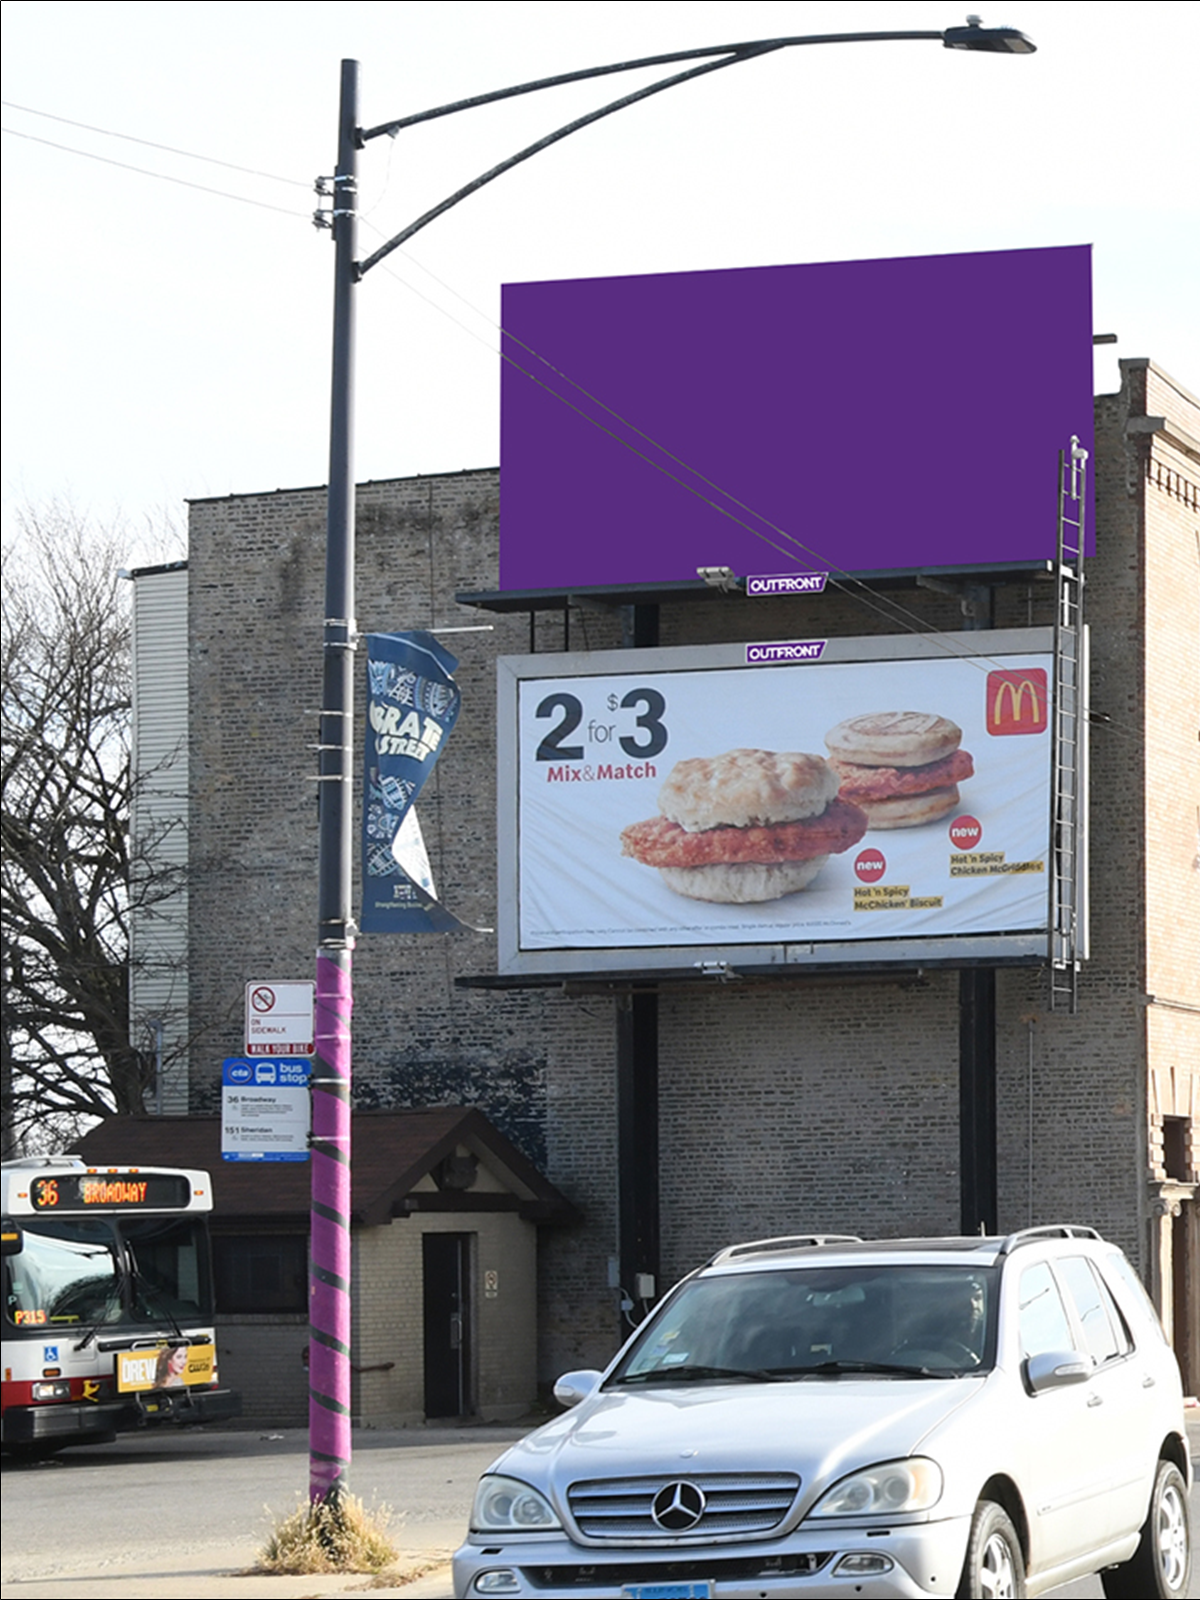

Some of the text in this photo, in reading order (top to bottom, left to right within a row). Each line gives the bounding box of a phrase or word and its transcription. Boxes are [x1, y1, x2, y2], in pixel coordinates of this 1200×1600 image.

[750, 577, 822, 592] OUTFRONT
[749, 645, 821, 660] OUTFRONT
[535, 692, 584, 761] 2
[588, 719, 616, 742] for
[952, 827, 979, 837] new
[950, 855, 967, 864] Hot
[980, 853, 1004, 864] Spicy
[857, 861, 883, 871] new
[950, 865, 988, 875] Chicken
[854, 888, 871, 897] Hot
[884, 886, 909, 897] Spicy
[909, 897, 942, 908] Biscuit
[251, 1026, 286, 1034] SIDEWALK
[279, 1063, 303, 1074] bus
[279, 1073, 308, 1085] stop
[226, 1096, 276, 1104] 36 Broadway
[36, 1179, 147, 1206] 36 BROADWAY
[14, 1309, 47, 1325] P315
